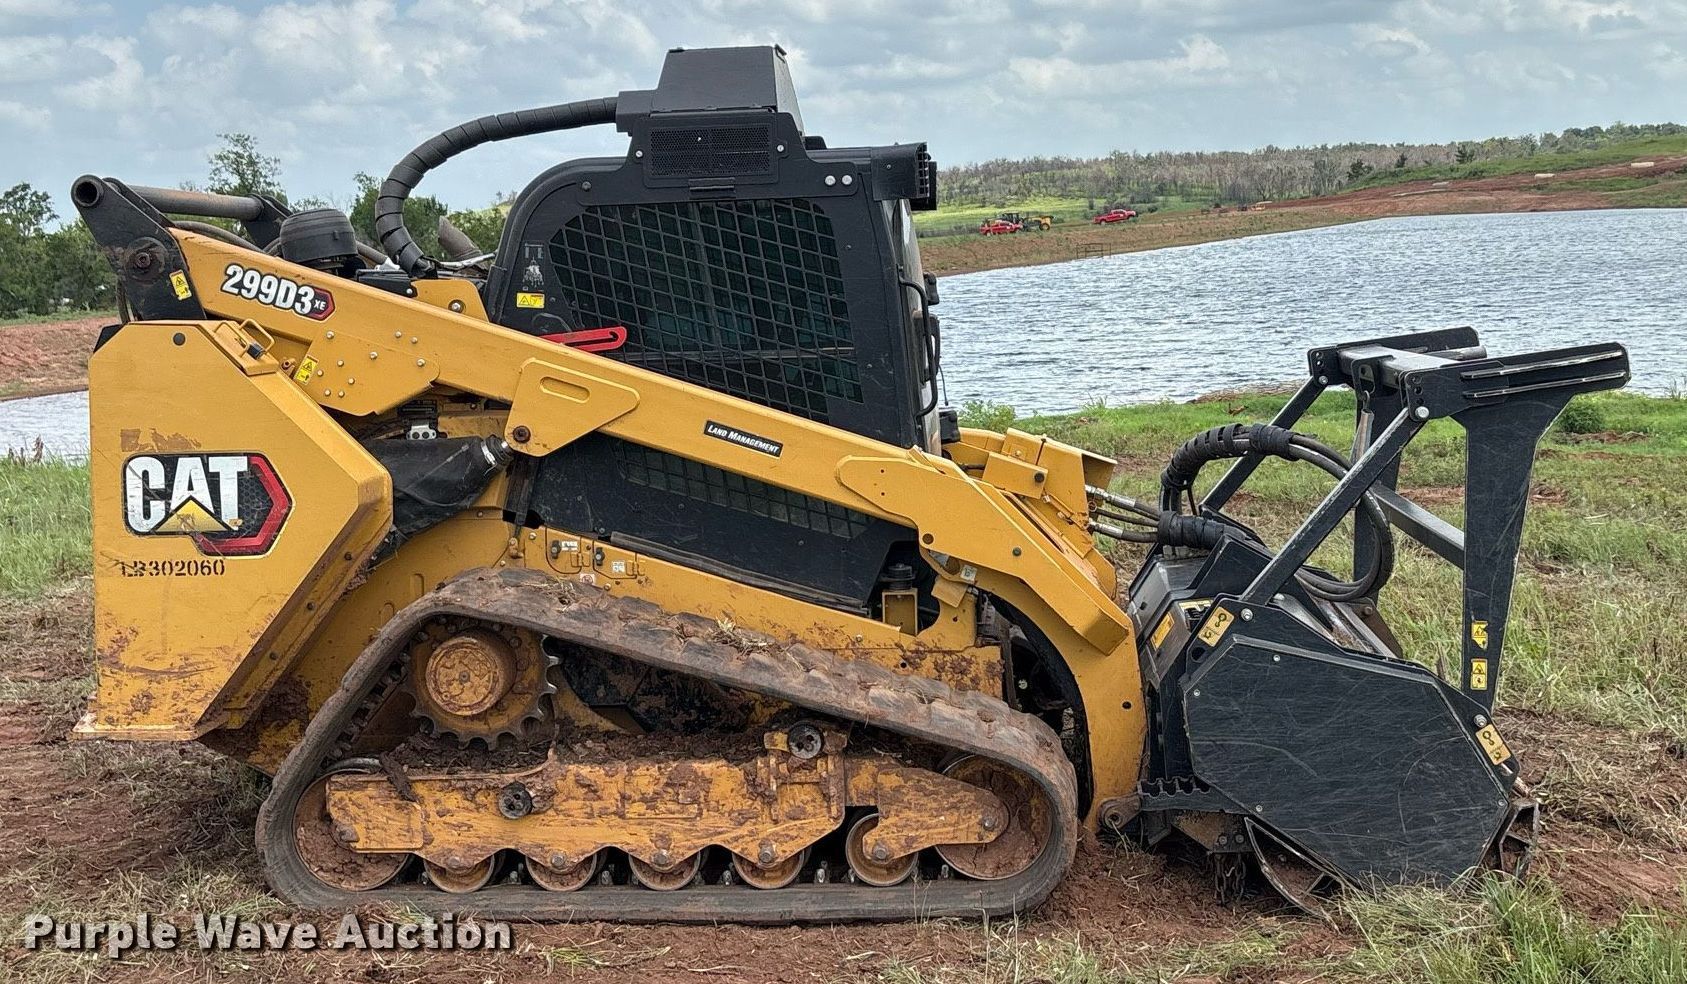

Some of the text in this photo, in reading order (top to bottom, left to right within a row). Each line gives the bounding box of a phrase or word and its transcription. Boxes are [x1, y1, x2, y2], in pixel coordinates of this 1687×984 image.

[222, 264, 327, 315] 299D3 XE
[125, 456, 248, 532] CAT
